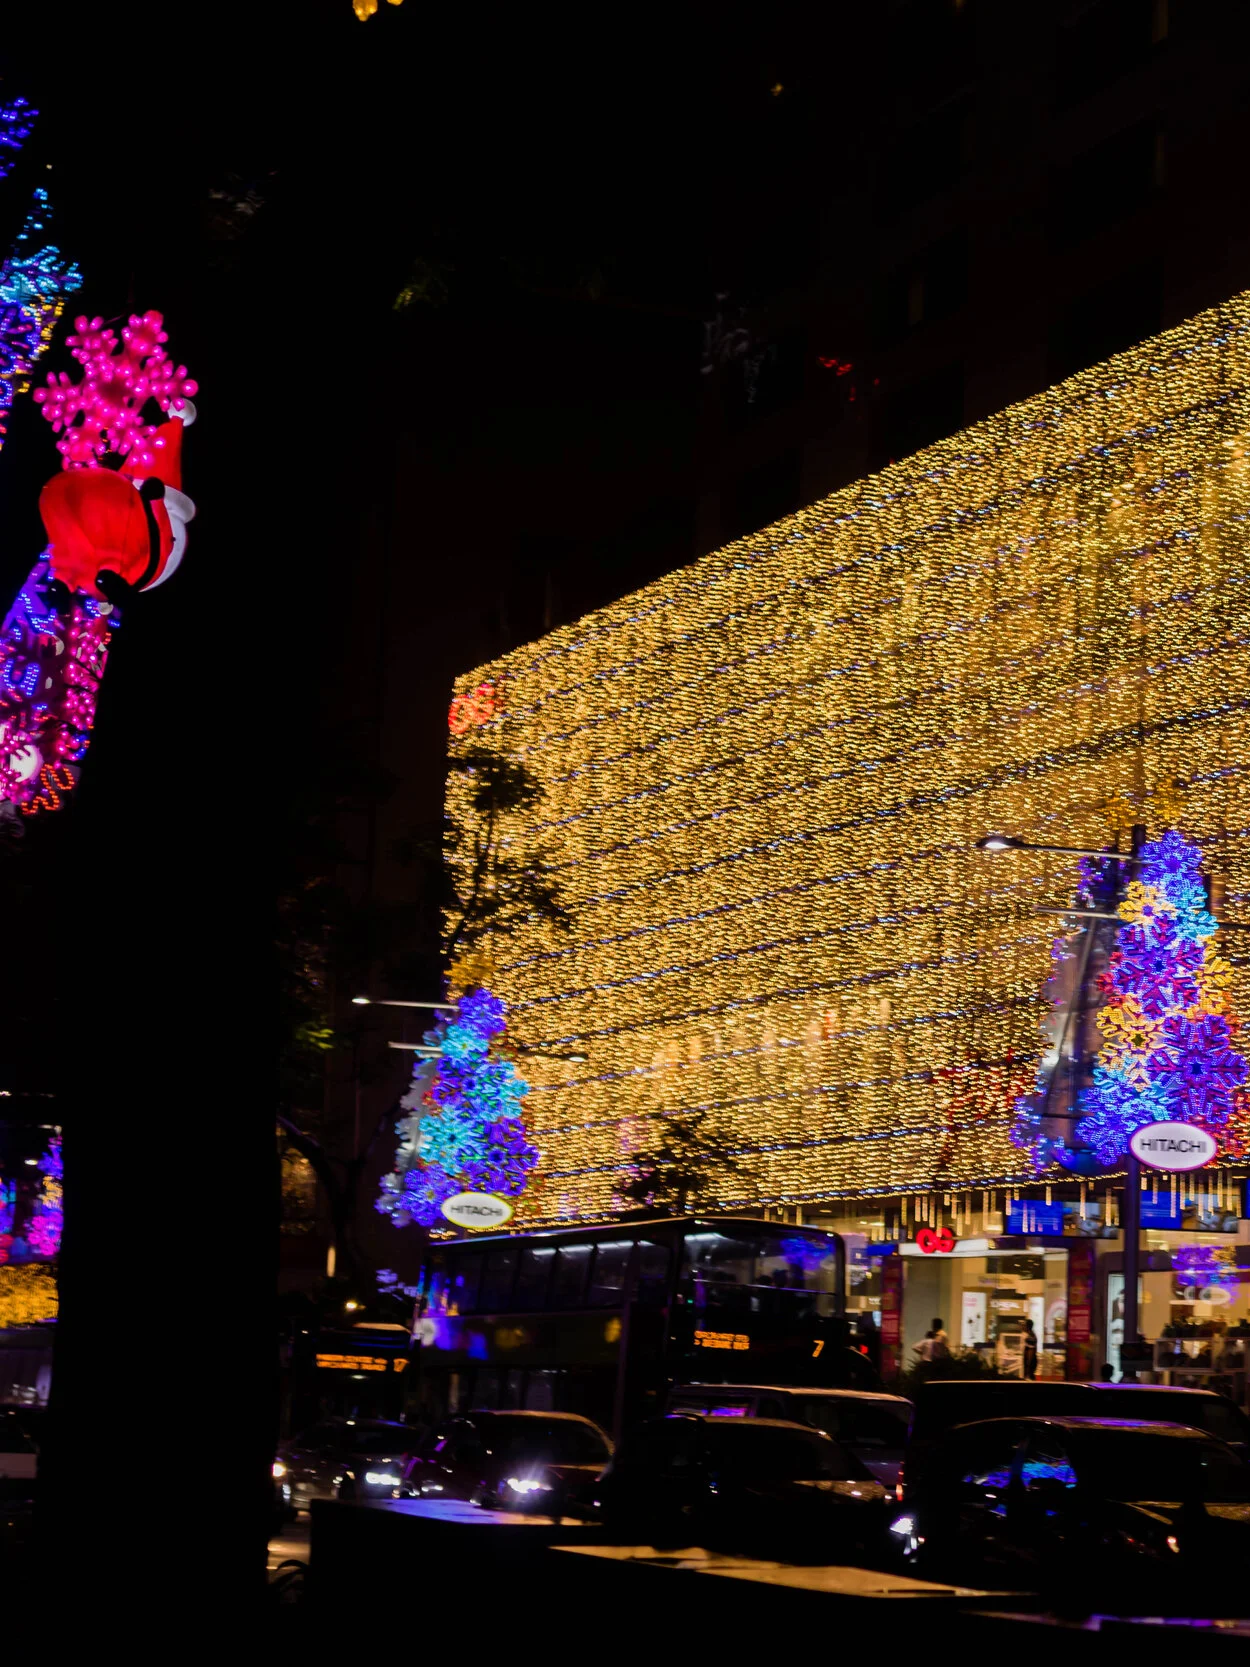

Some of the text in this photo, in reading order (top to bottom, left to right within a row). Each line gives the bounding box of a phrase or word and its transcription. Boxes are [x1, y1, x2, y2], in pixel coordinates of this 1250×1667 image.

[1140, 1138, 1207, 1154] HITACHI
[450, 1204, 503, 1217] HITACHI
[915, 1227, 955, 1254] OG
[812, 1339, 825, 1358] 7
